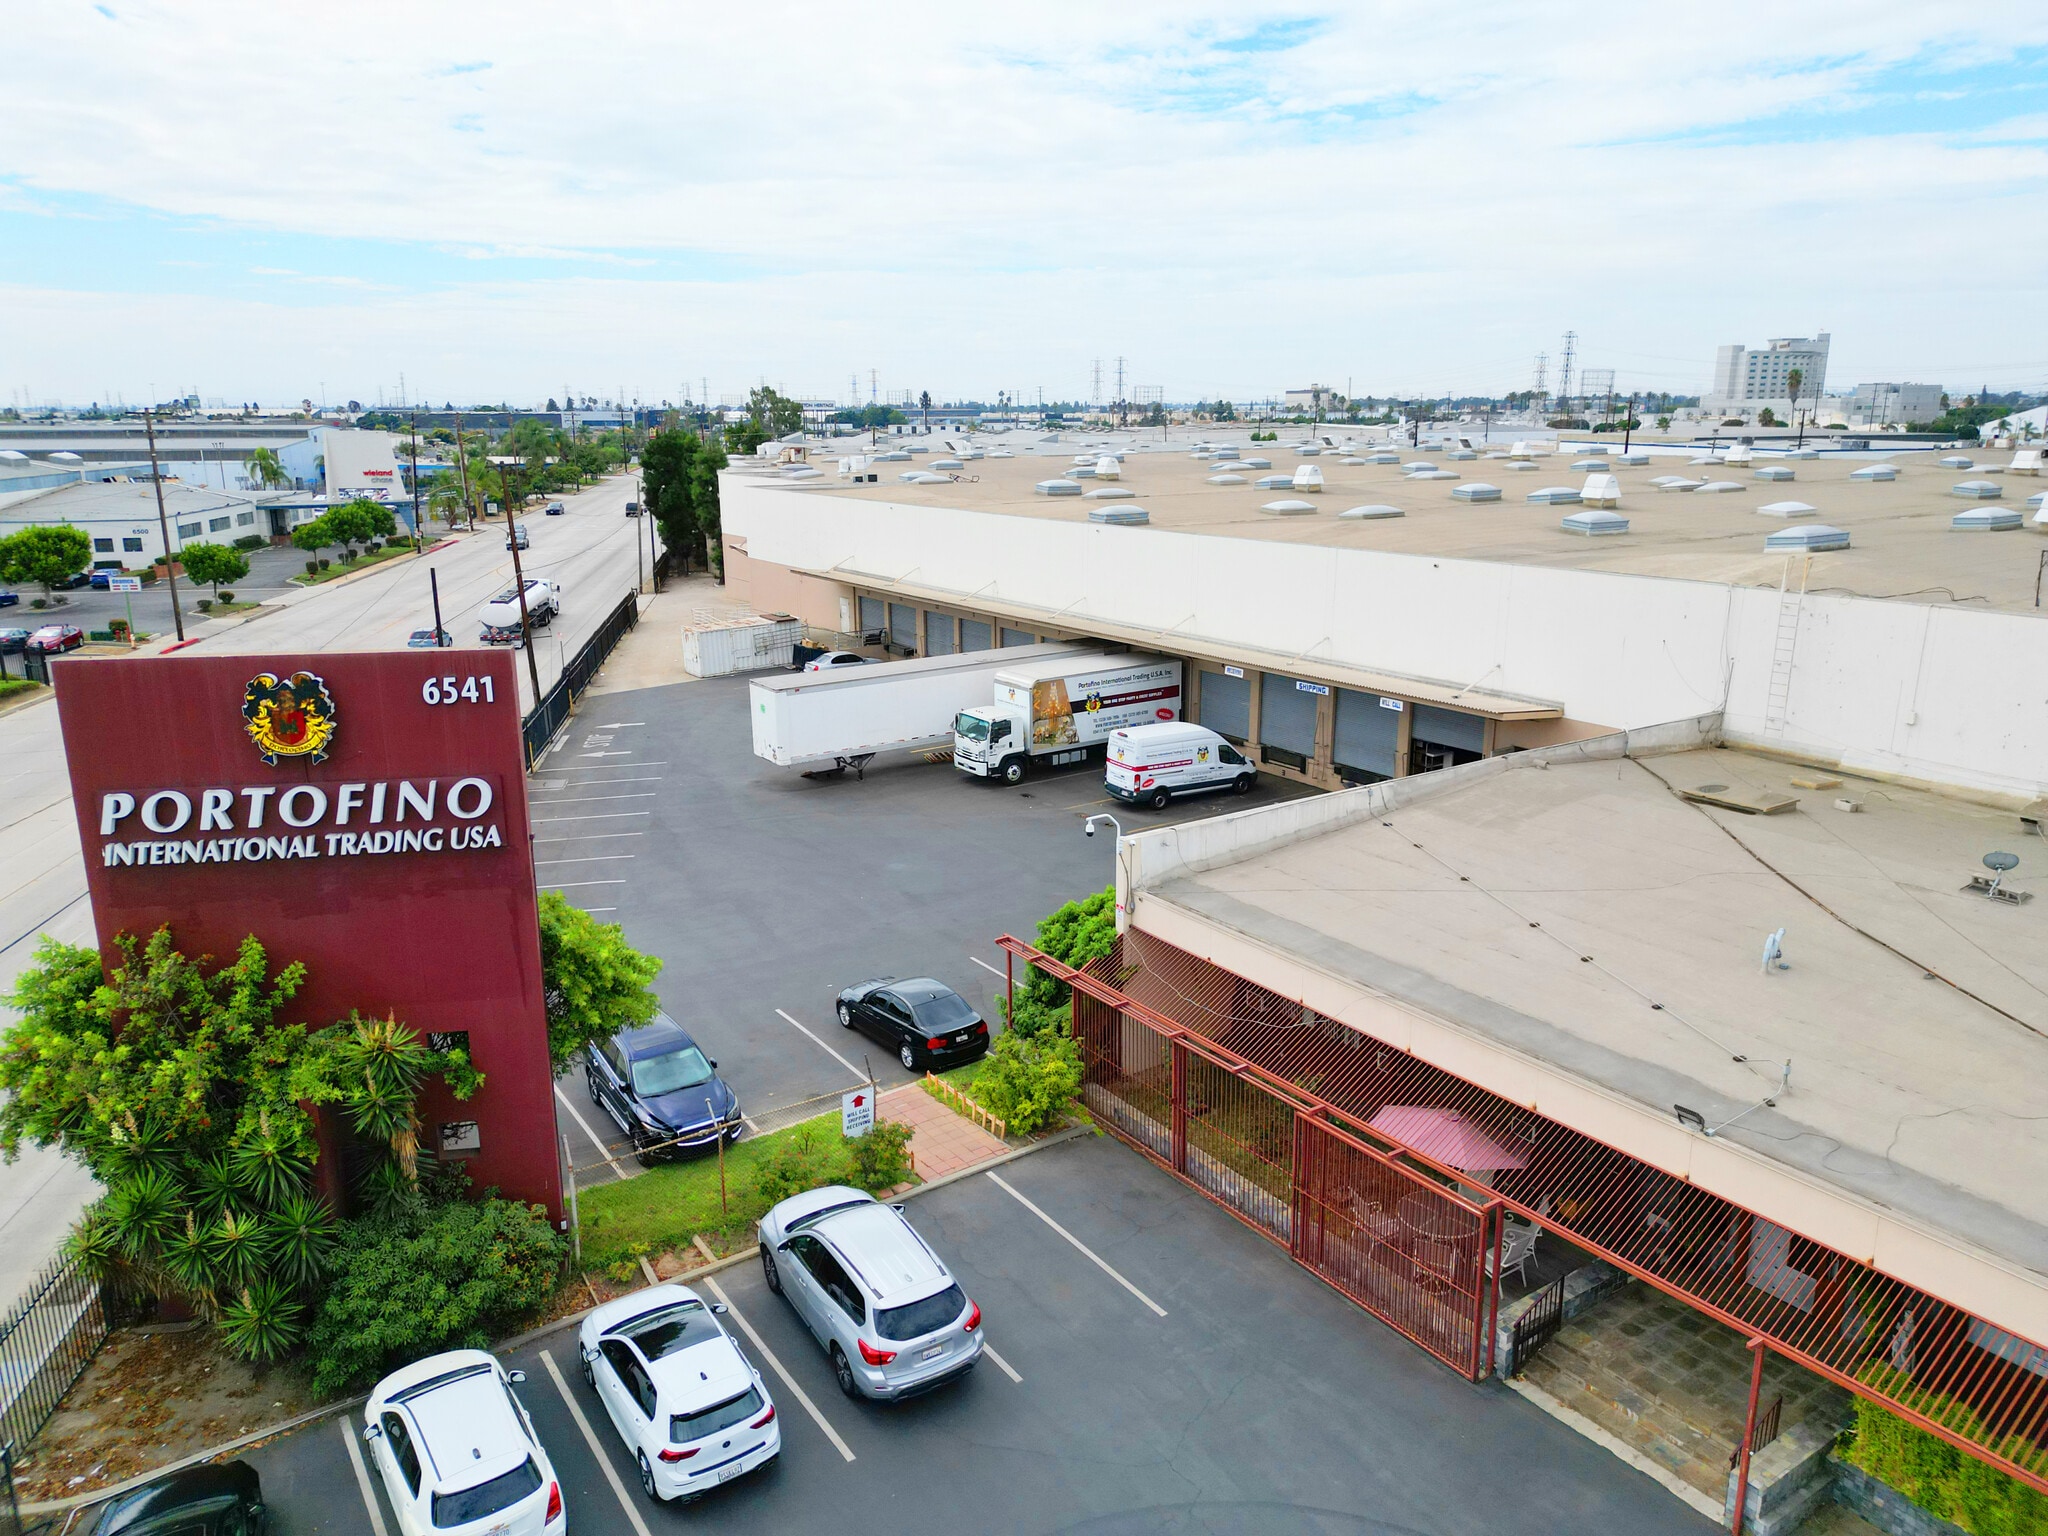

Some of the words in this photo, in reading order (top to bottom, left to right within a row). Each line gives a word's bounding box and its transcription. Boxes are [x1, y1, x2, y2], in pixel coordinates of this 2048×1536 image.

[1101, 676, 1132, 685] International
[1132, 673, 1150, 681] Trading
[422, 675, 494, 705] 6541
[1298, 683, 1326, 694] SHIPPING
[100, 777, 493, 835] PORTOFINO
[103, 834, 320, 867] INTERNATIONAL
[325, 827, 443, 857] TRADING
[450, 824, 502, 850] USA
[846, 1119, 871, 1130] RECEIVING
[848, 1113, 870, 1124] SHIPPING
